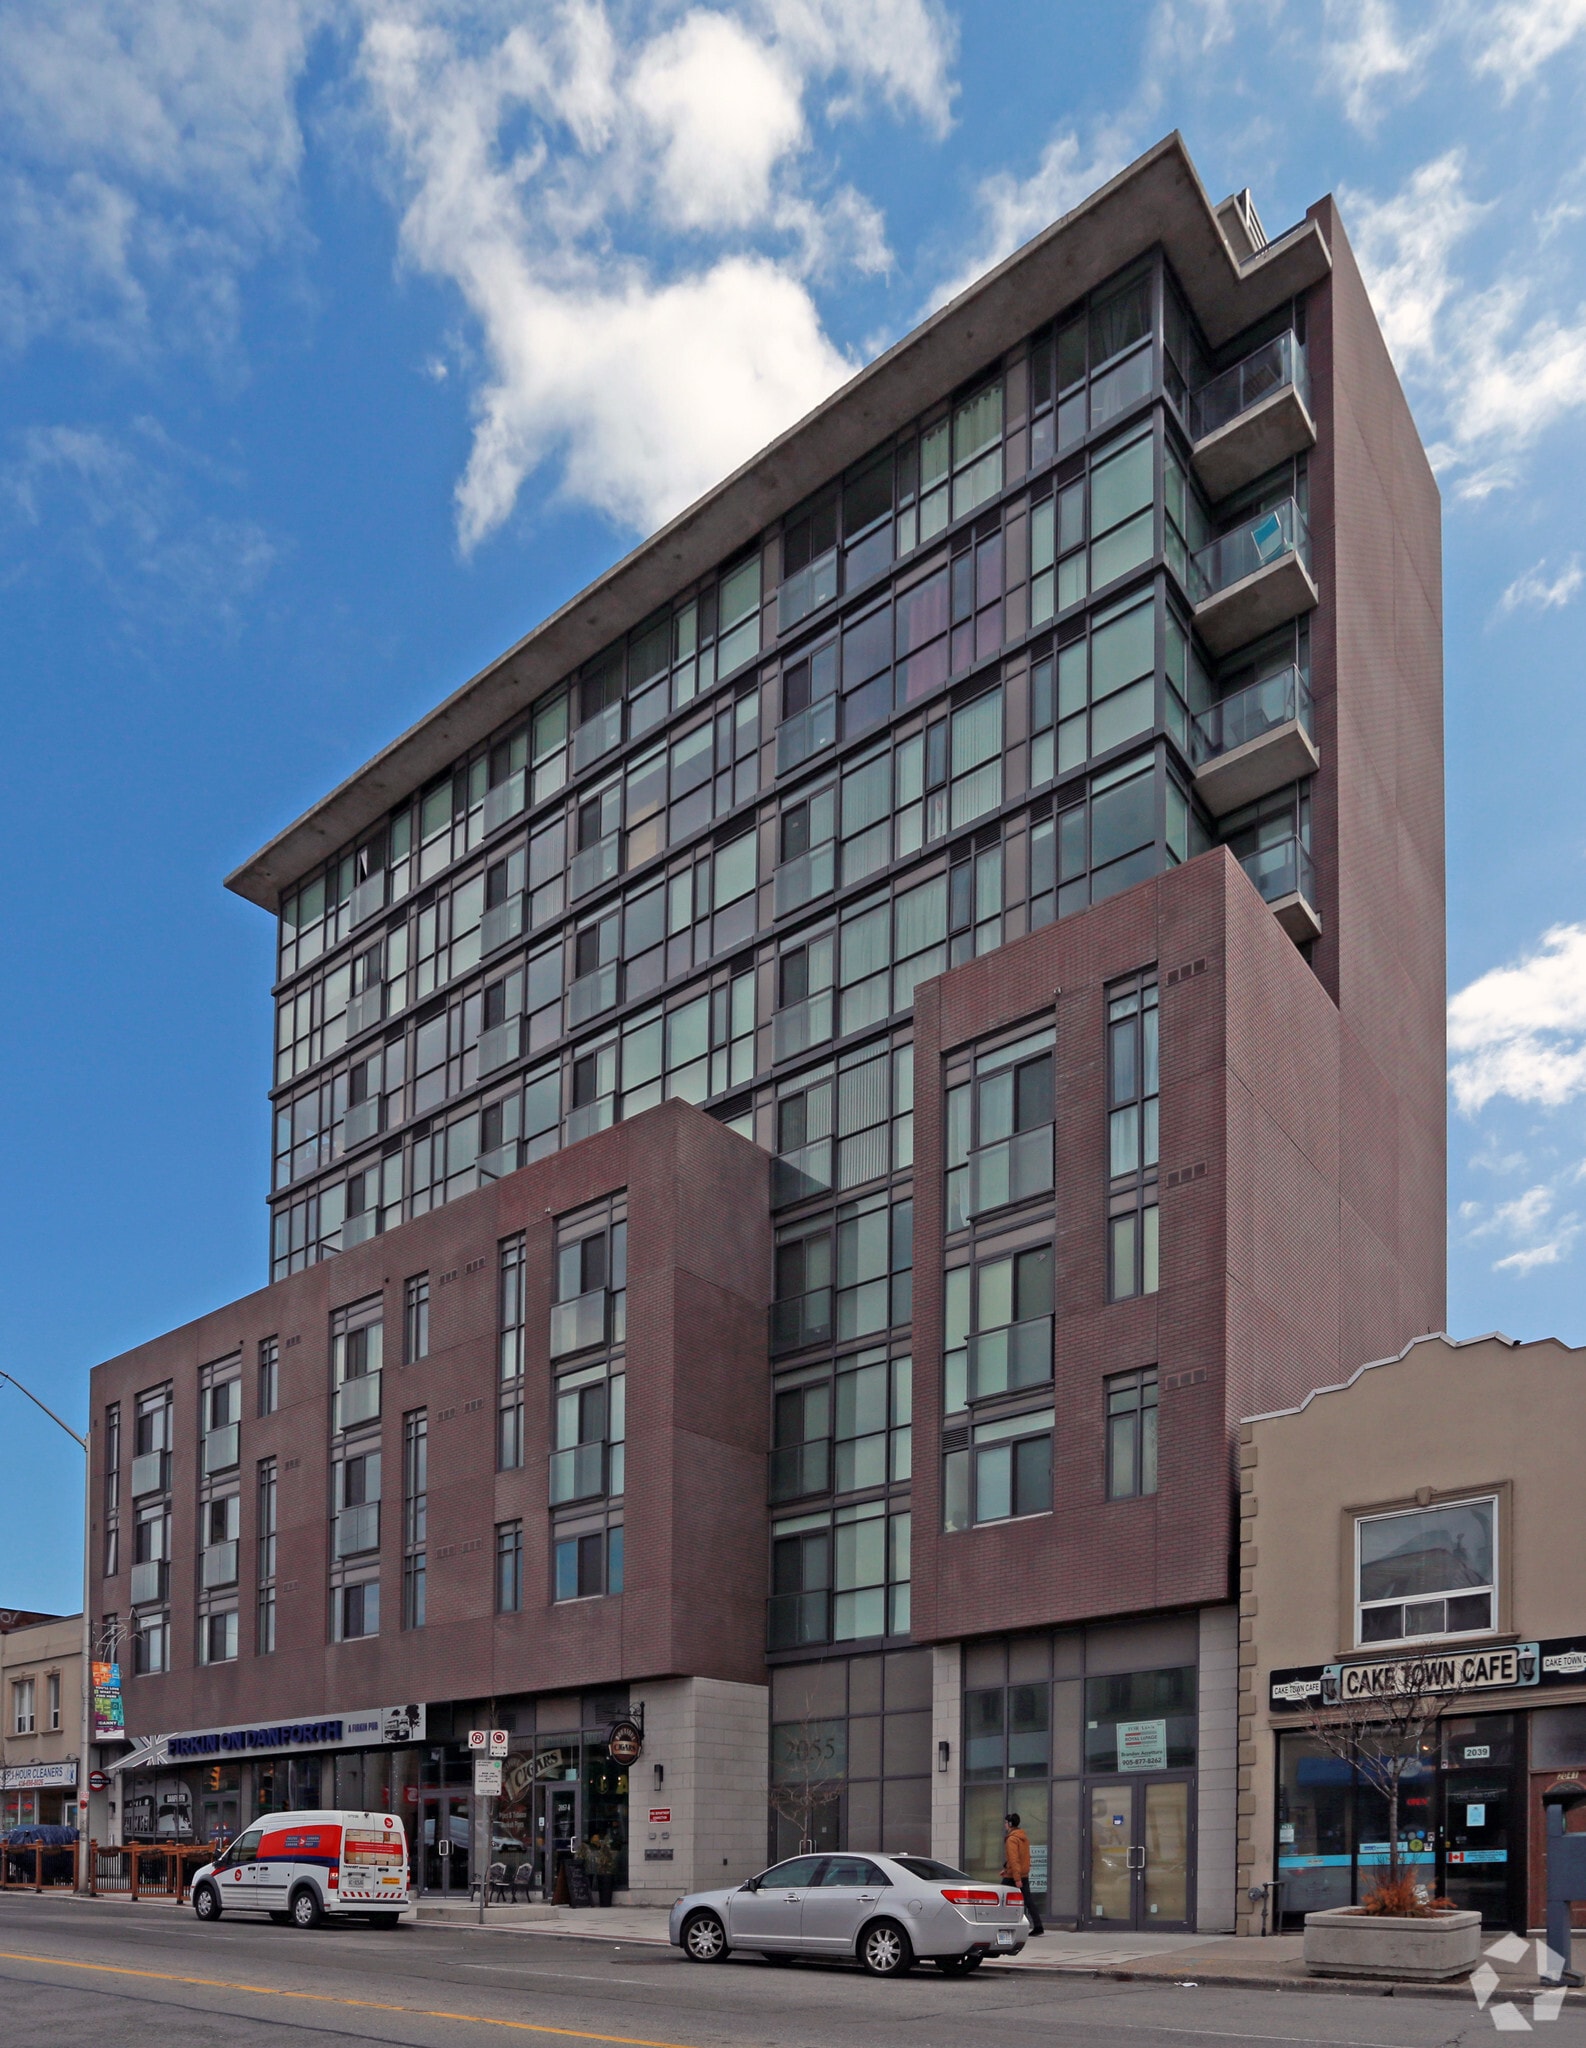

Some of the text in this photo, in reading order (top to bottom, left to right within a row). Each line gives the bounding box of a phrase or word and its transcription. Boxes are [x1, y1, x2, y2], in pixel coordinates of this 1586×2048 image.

[1545, 1659, 1562, 1667] CAKE
[1563, 1656, 1582, 1665] TOWN
[1347, 1654, 1513, 1695] CAKE TOWN CAFE
[1274, 1682, 1320, 1695] CAKE TOWN CAFE
[368, 1721, 378, 1731] PUB
[167, 1720, 343, 1756] FIRKIN ON DANFORTH
[613, 1743, 637, 1752] CIGARS
[1466, 1748, 1488, 1757] 2039
[32, 1766, 63, 1779] CLEANERS
[514, 1751, 559, 1788] CIGARS
